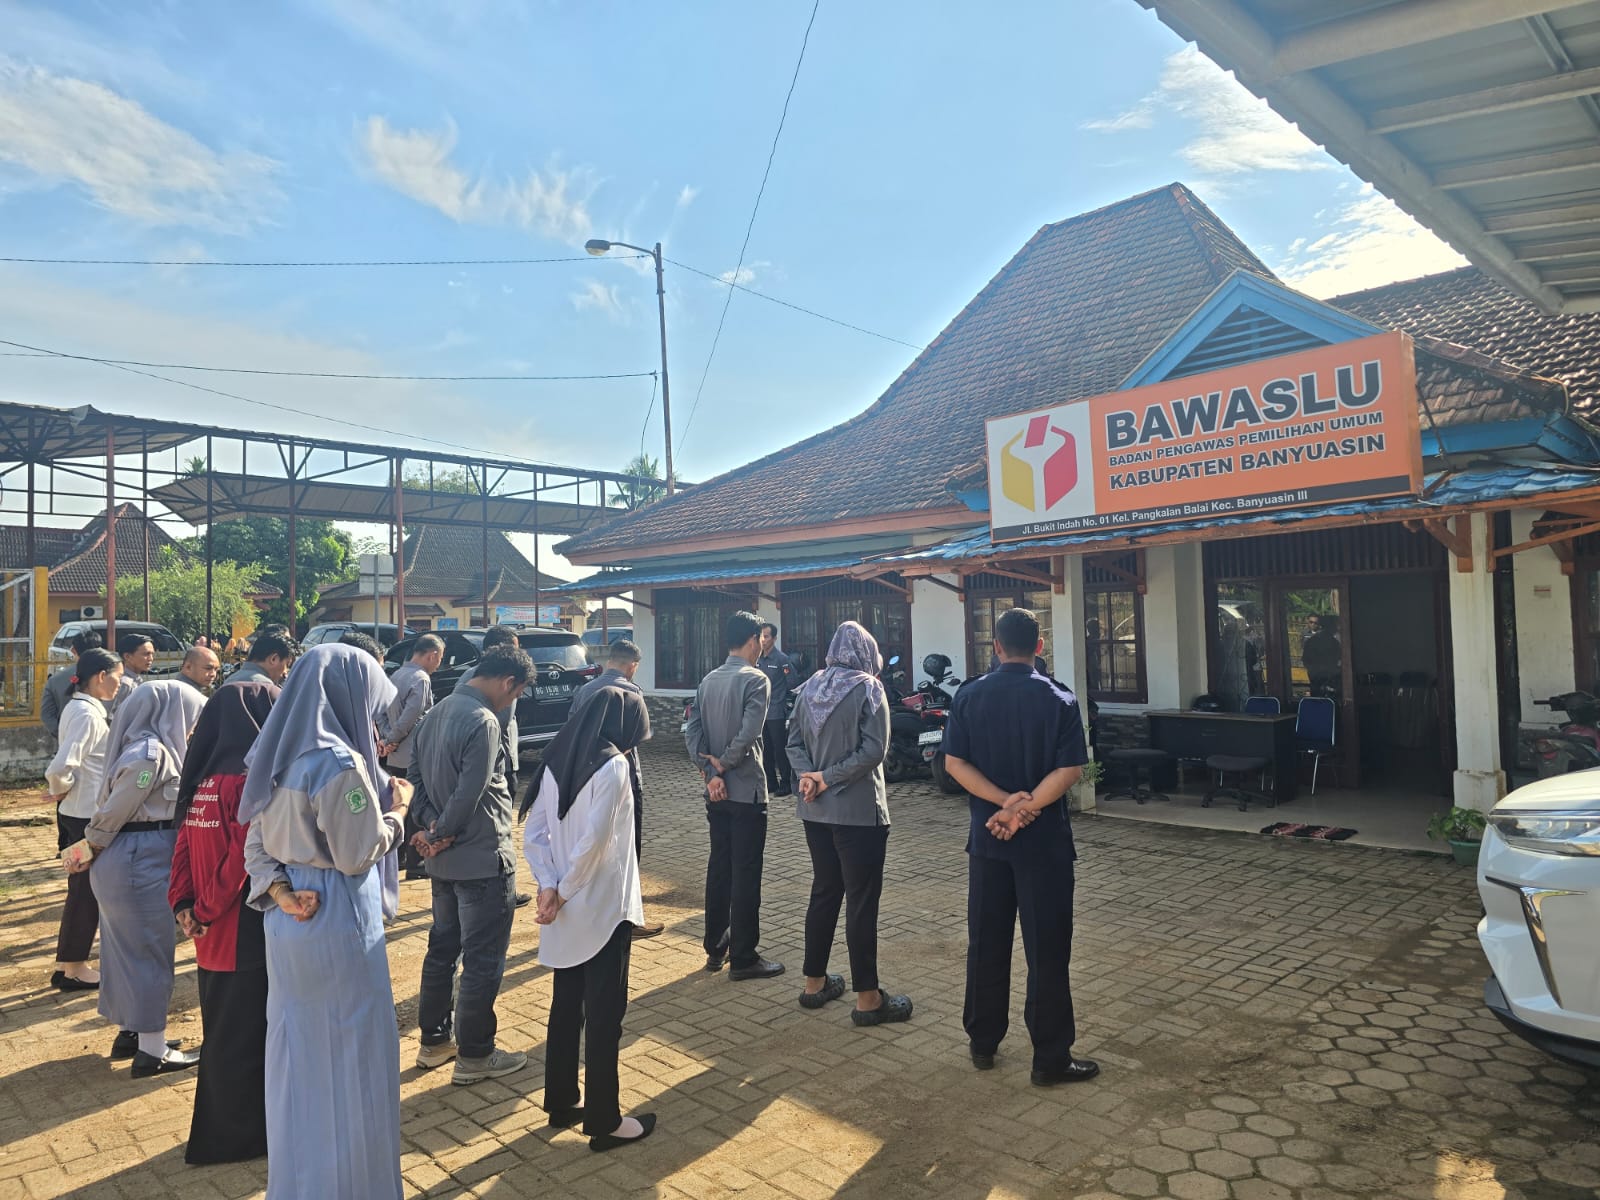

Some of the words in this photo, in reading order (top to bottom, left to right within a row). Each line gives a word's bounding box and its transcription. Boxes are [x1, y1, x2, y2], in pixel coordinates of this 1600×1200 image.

[1105, 359, 1382, 451] BAWASLU
[1109, 450, 1153, 467] BADAN
[1156, 436, 1235, 459] PENGAWAS
[1238, 421, 1325, 446] PEMILIHAN
[1329, 410, 1383, 431] UMUM
[1110, 456, 1234, 490] KABUPATEN
[1240, 432, 1385, 471] BANYUASIN
[1022, 526, 1032, 535] Jl.
[1034, 523, 1055, 533] Bukit
[1057, 519, 1080, 530] Indah
[1082, 516, 1098, 527] No.
[1099, 514, 1110, 525] 01
[1112, 511, 1130, 523] Kel.
[1132, 506, 1181, 521] Pangkalan
[1184, 503, 1209, 515] Balai
[1211, 500, 1234, 511] Kec.
[1237, 492, 1294, 508] Banyuasin
[1297, 490, 1308, 501] III
